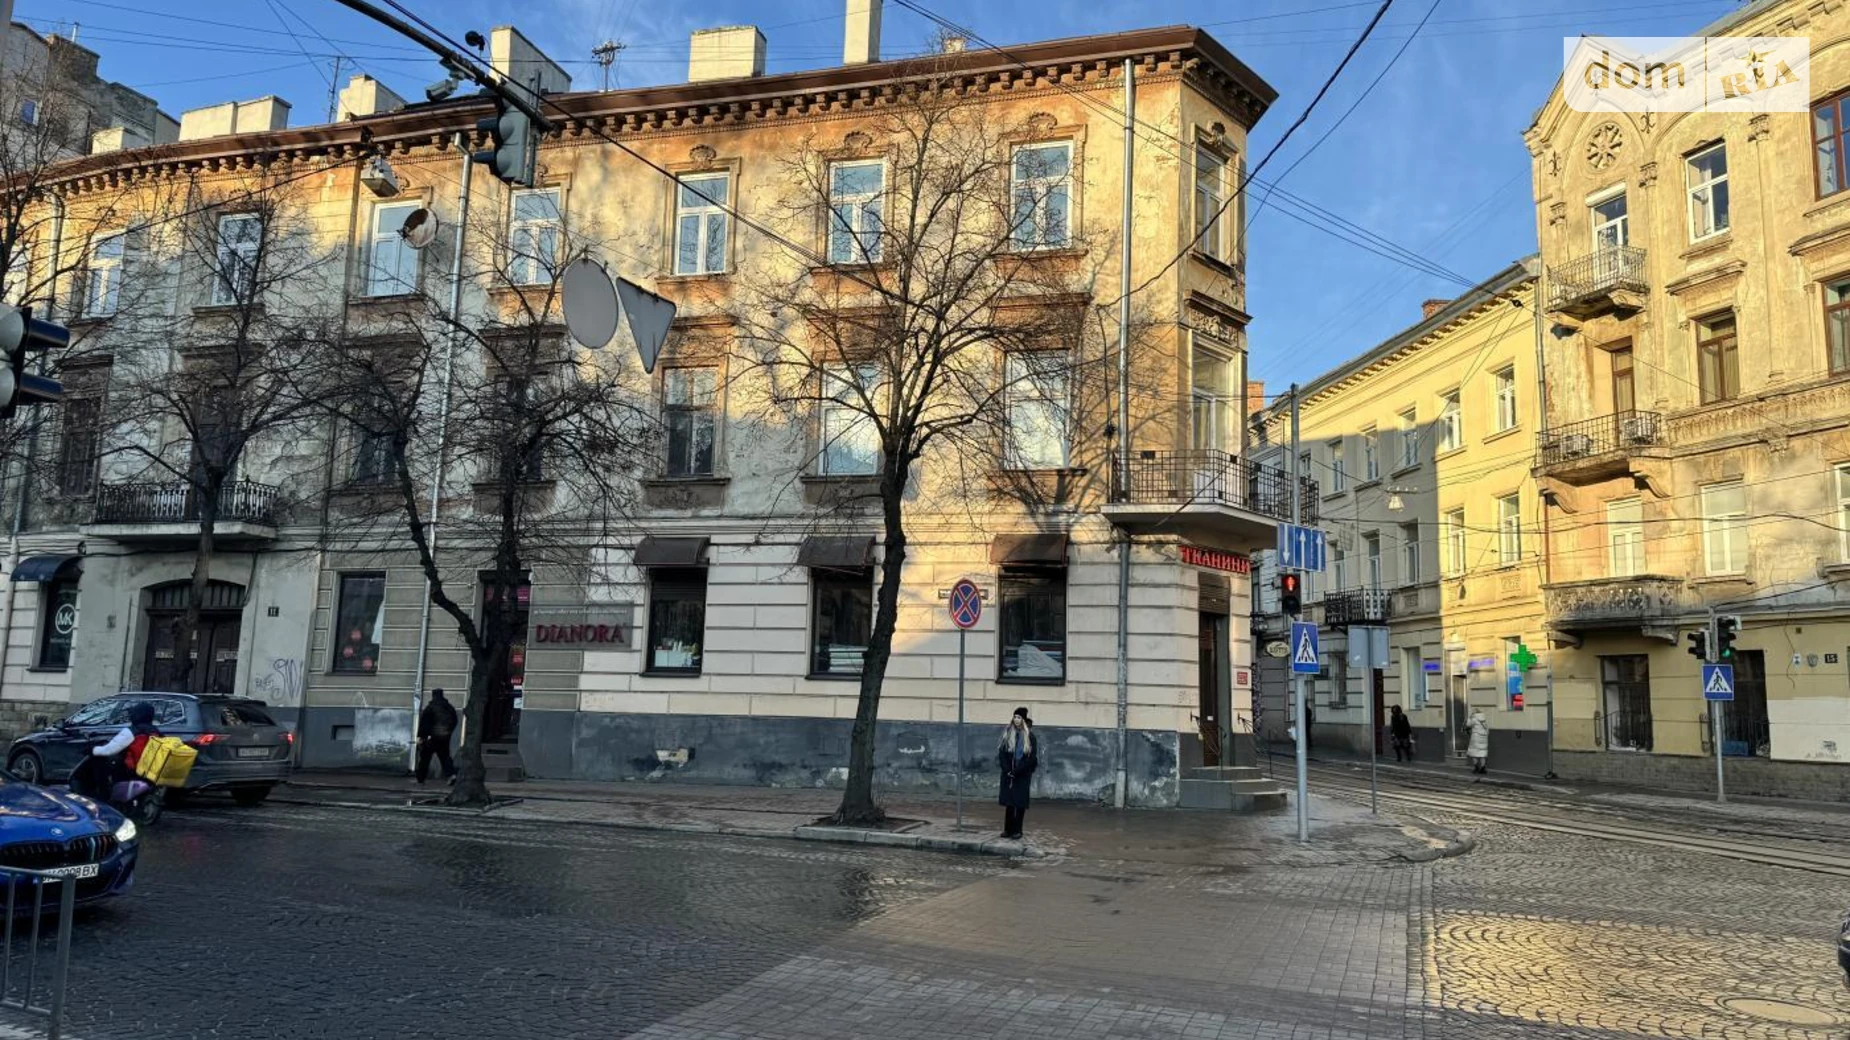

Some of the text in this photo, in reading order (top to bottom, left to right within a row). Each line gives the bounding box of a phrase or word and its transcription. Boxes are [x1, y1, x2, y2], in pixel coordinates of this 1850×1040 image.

[1180, 547, 1250, 574] ТКАНИНИ
[57, 611, 73, 626] MK
[536, 624, 624, 643] DIANORA
